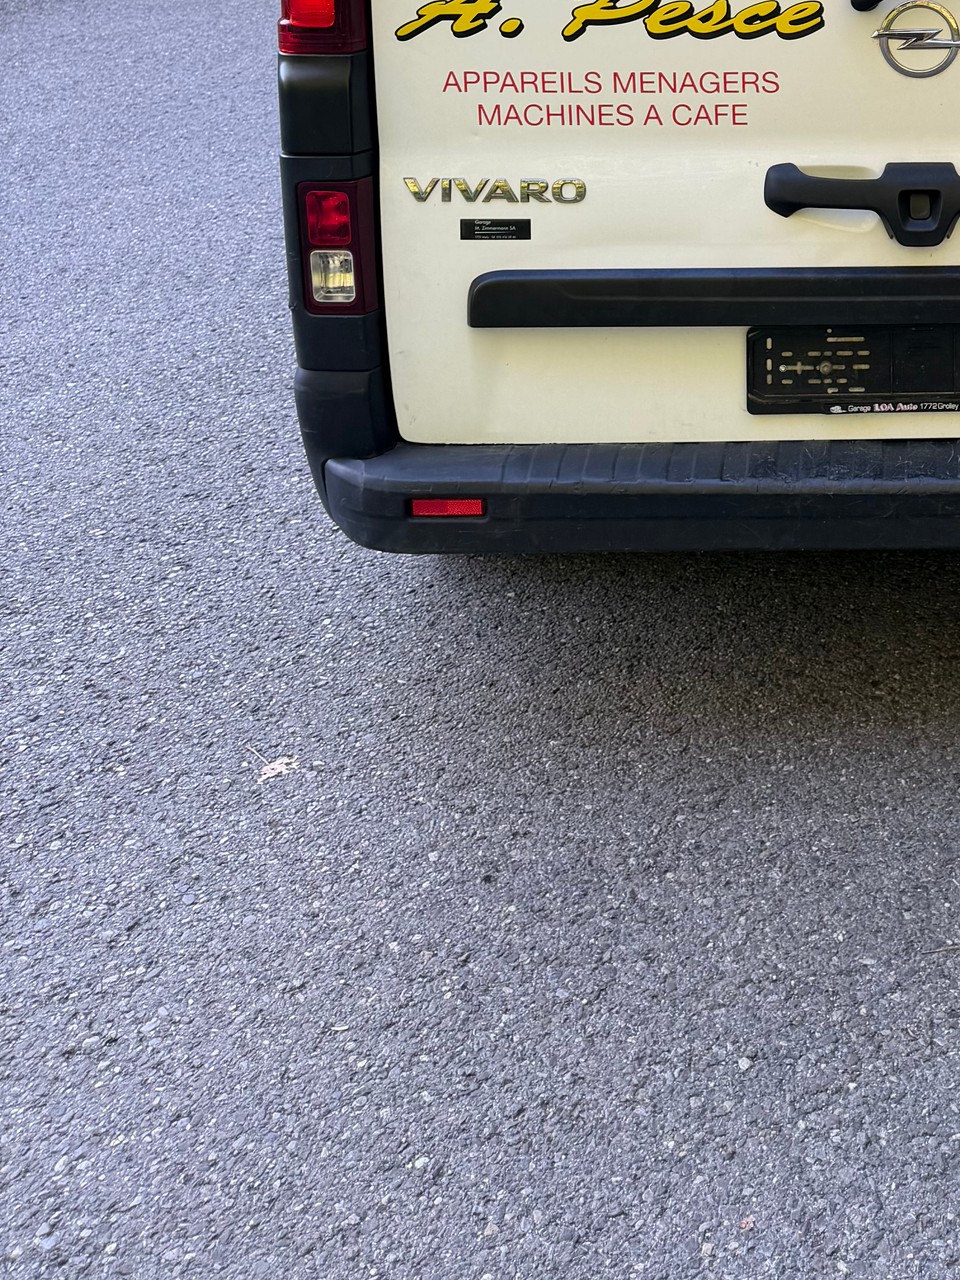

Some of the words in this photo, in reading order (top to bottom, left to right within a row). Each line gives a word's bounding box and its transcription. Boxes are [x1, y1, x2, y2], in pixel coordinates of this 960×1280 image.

[442, 70, 602, 94] APPAREILS
[612, 70, 780, 94] MENAGERS
[477, 103, 634, 126] MACHINES
[643, 104, 663, 126] A
[671, 103, 748, 126] CAFE
[403, 177, 587, 205] VIVARO
[847, 405, 872, 413] Garage
[895, 402, 918, 411] Auto
